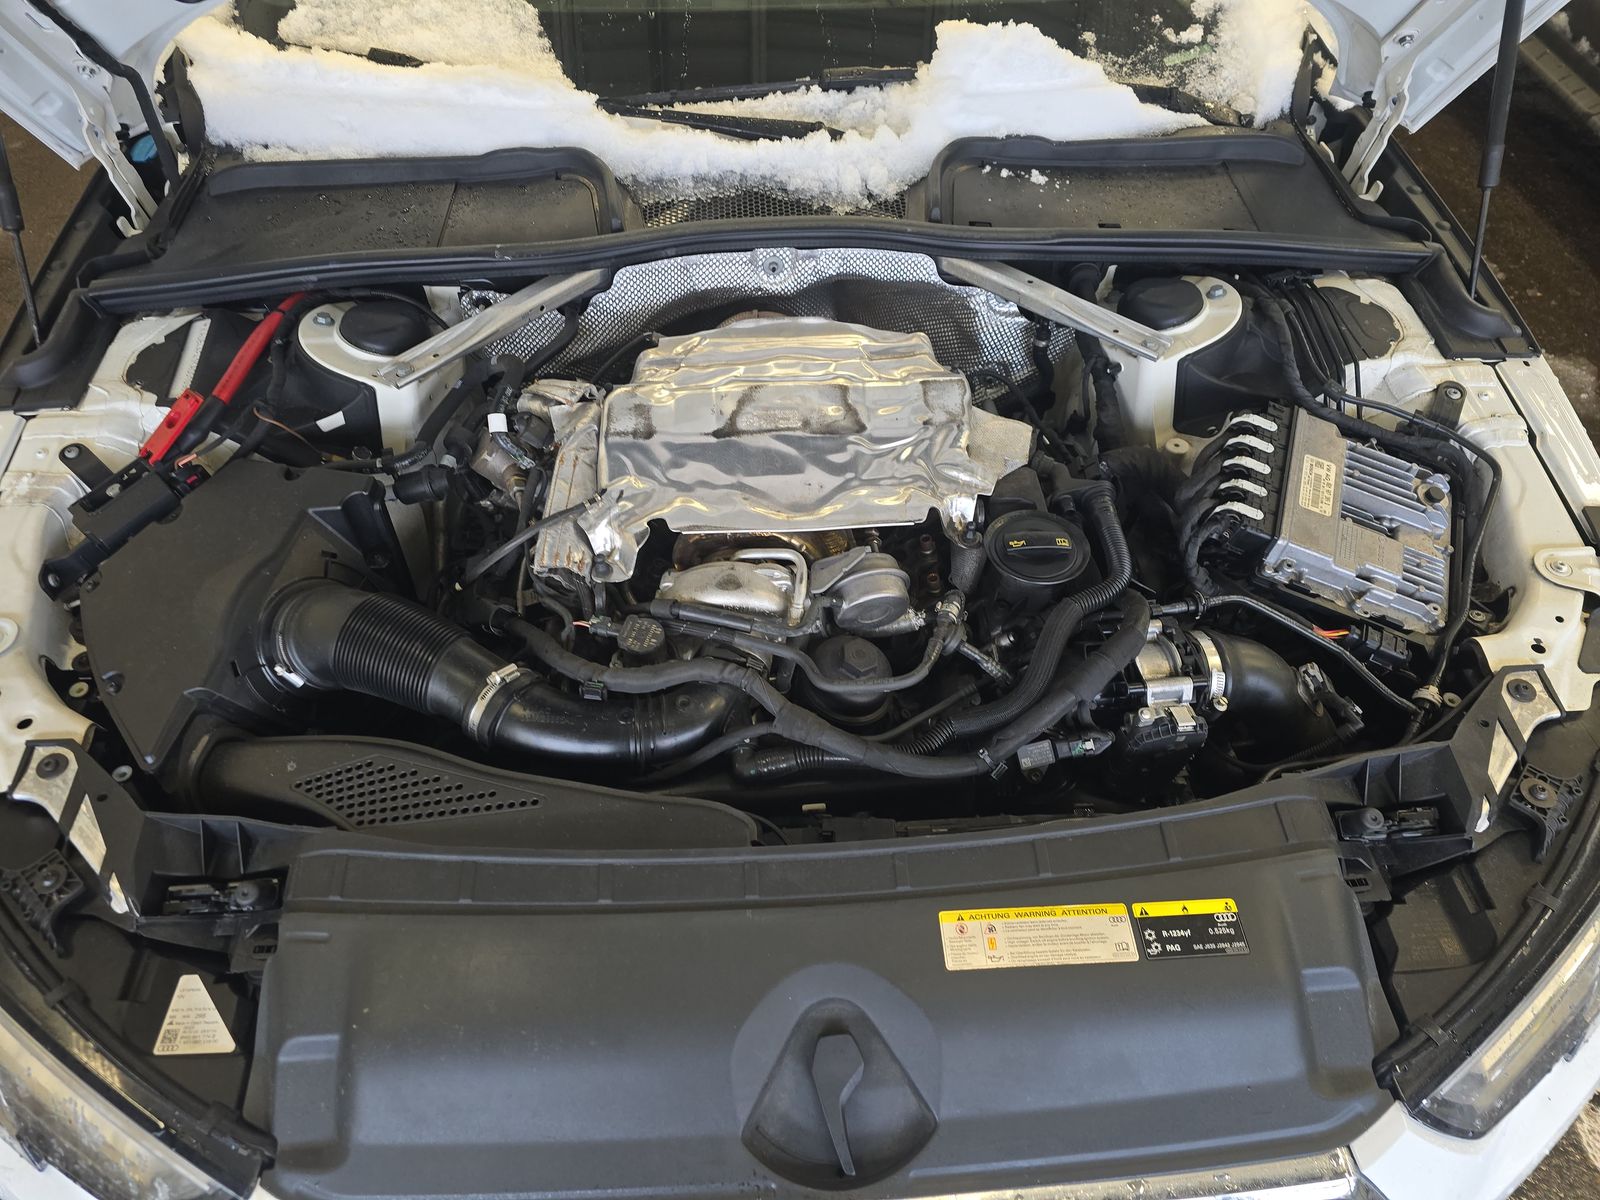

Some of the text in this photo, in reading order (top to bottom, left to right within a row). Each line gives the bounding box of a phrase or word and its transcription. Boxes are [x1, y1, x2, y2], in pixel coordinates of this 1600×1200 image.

[968, 907, 1108, 921] ACHTUNG WARNING ATTENTION
[1165, 943, 1181, 952] PAG
